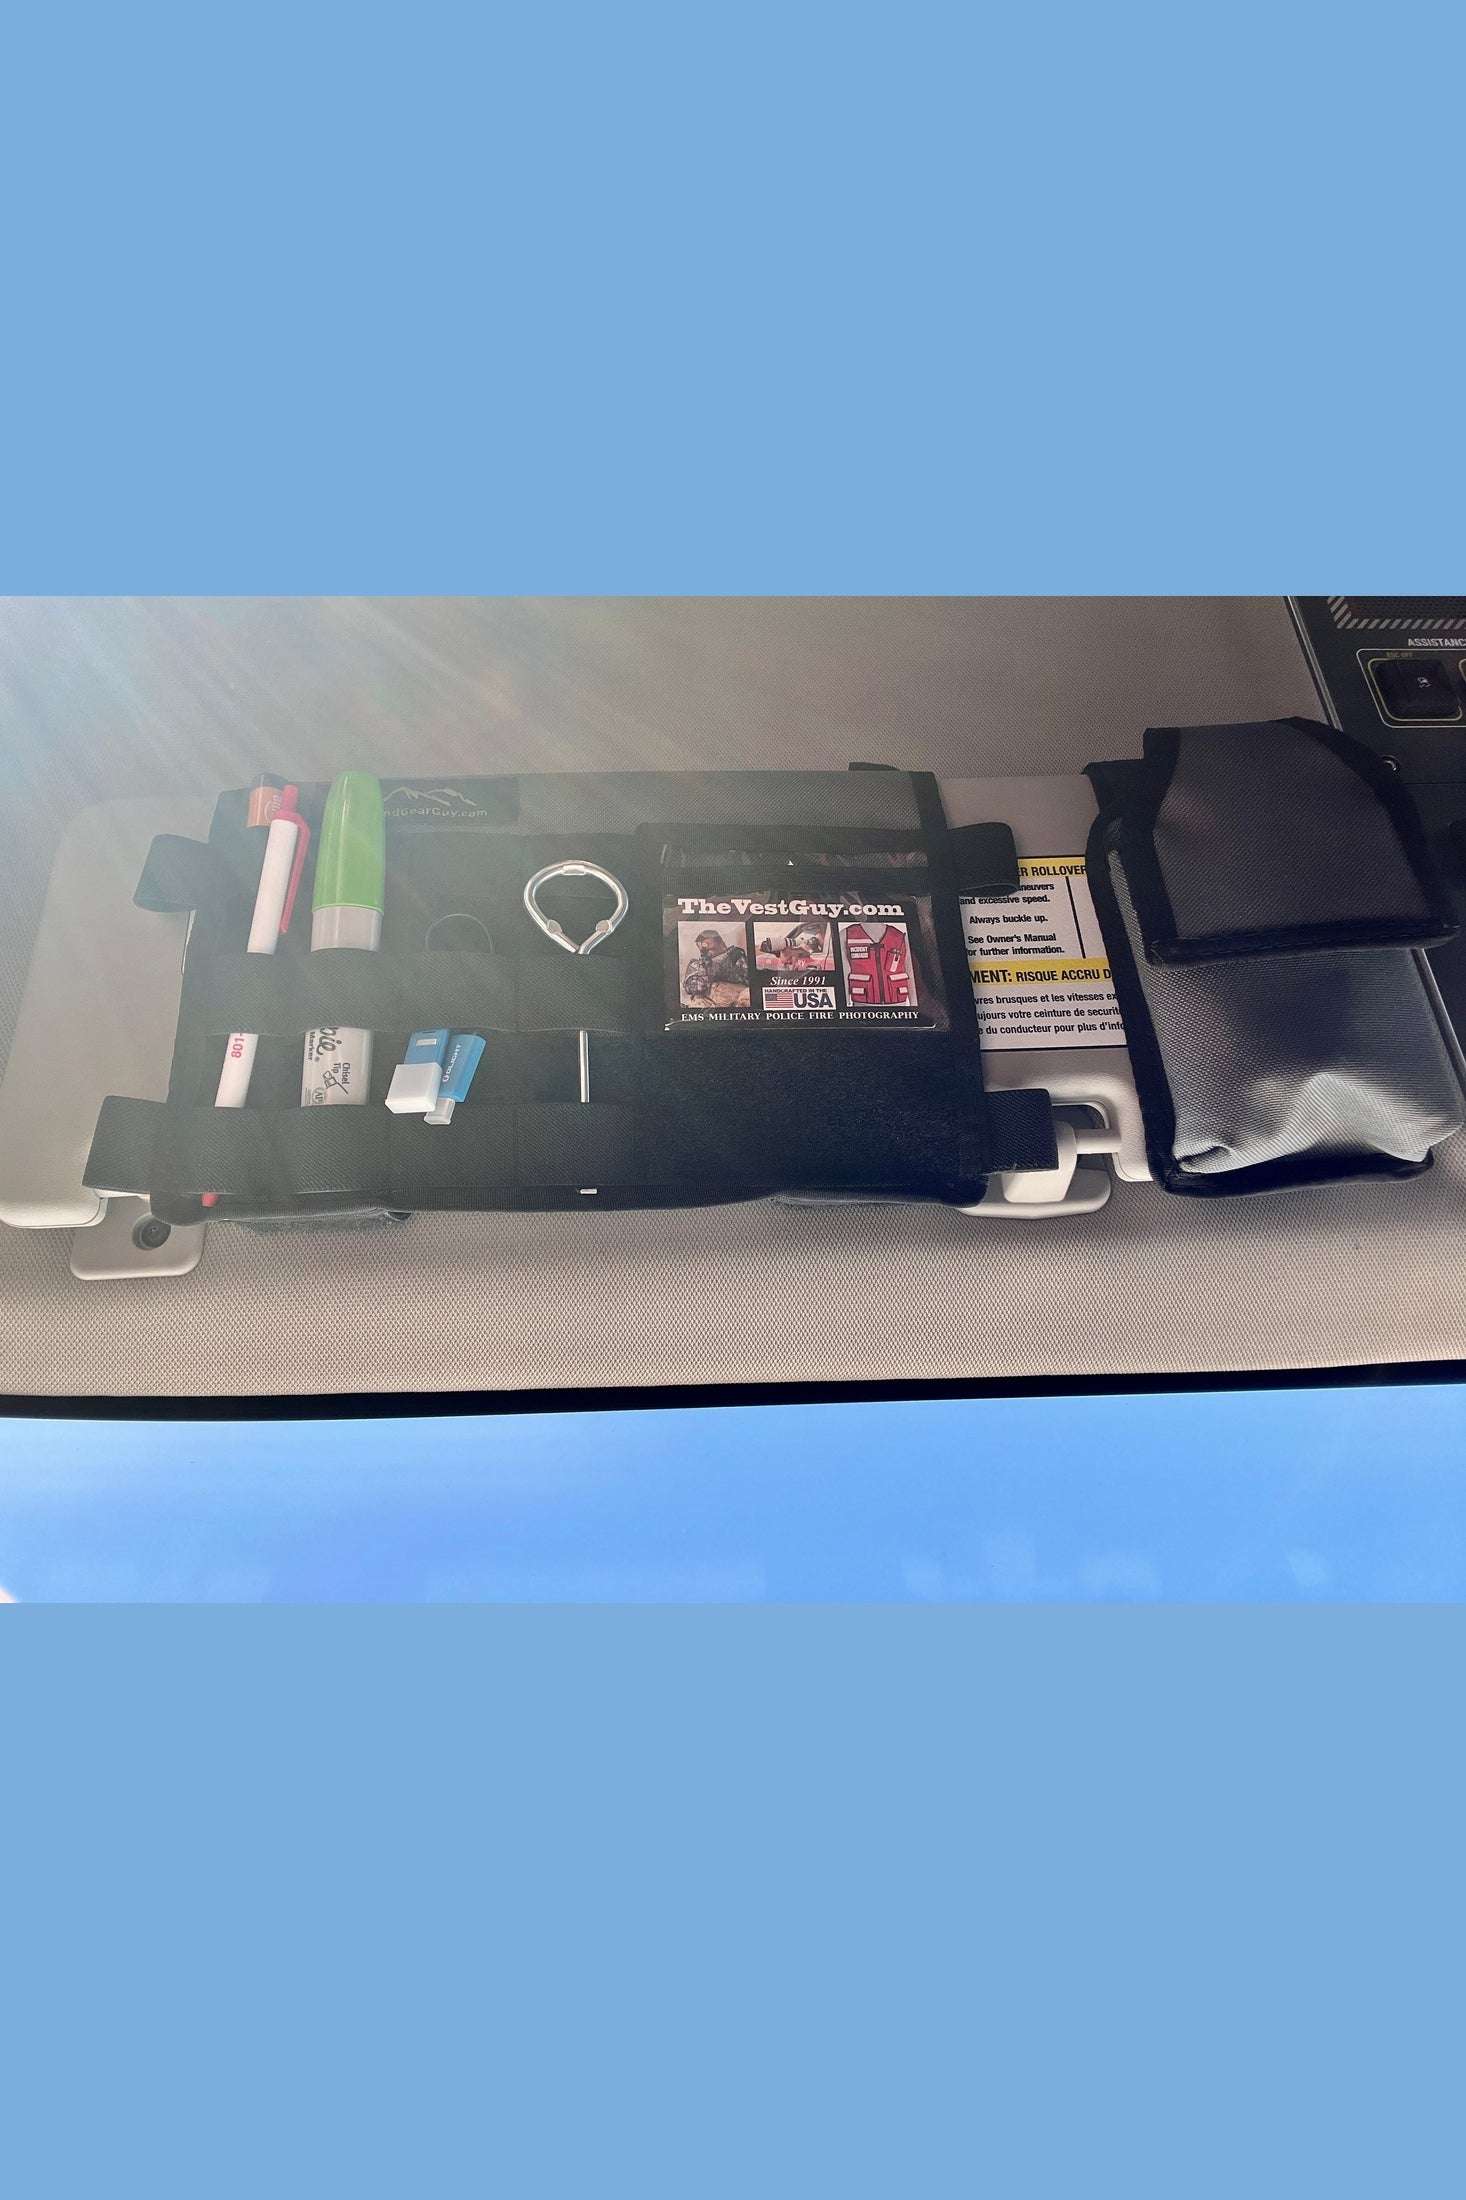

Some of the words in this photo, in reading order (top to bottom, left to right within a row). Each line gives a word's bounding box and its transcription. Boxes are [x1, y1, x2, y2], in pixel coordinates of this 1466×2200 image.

[1018, 883, 1055, 892] neuvers
[978, 895, 1020, 905] excessive
[1022, 894, 1051, 904] speed.
[678, 898, 904, 918] TheVestGuy.com
[969, 915, 1001, 925] Always
[1002, 914, 1032, 923] buckle
[1034, 915, 1049, 924] up.
[967, 935, 985, 944] See
[986, 934, 1022, 943] Owner's
[1023, 933, 1057, 942] Manual
[979, 947, 1009, 956] further
[1011, 946, 1065, 955] information.
[770, 976, 800, 986] Since
[802, 976, 826, 986] 1991
[1015, 971, 1059, 982] RISQUE
[1061, 969, 1101, 980] ACCRU
[793, 993, 834, 1008] USA
[995, 995, 1038, 1005] brusques
[1040, 994, 1050, 1003] et
[1051, 994, 1065, 1002] les
[1067, 993, 1105, 1002] vitesses
[681, 1013, 705, 1021] EMS
[708, 1012, 761, 1021] MILITARY
[766, 1011, 804, 1020] POLICE
[809, 1011, 834, 1020] FIRE
[839, 1011, 919, 1020] PHOTOGRAPHY
[1008, 1010, 1032, 1019] votre
[1034, 1009, 1072, 1018] ceinture
[1074, 1008, 1085, 1017] de
[1087, 1006, 1120, 1016] securit
[985, 1025, 998, 1035] du
[999, 1024, 1052, 1034] conducteur
[1053, 1024, 1075, 1034] pour
[1077, 1022, 1098, 1033] plus
[331, 1062, 341, 1074] Tip
[341, 1062, 351, 1085] Chisel
